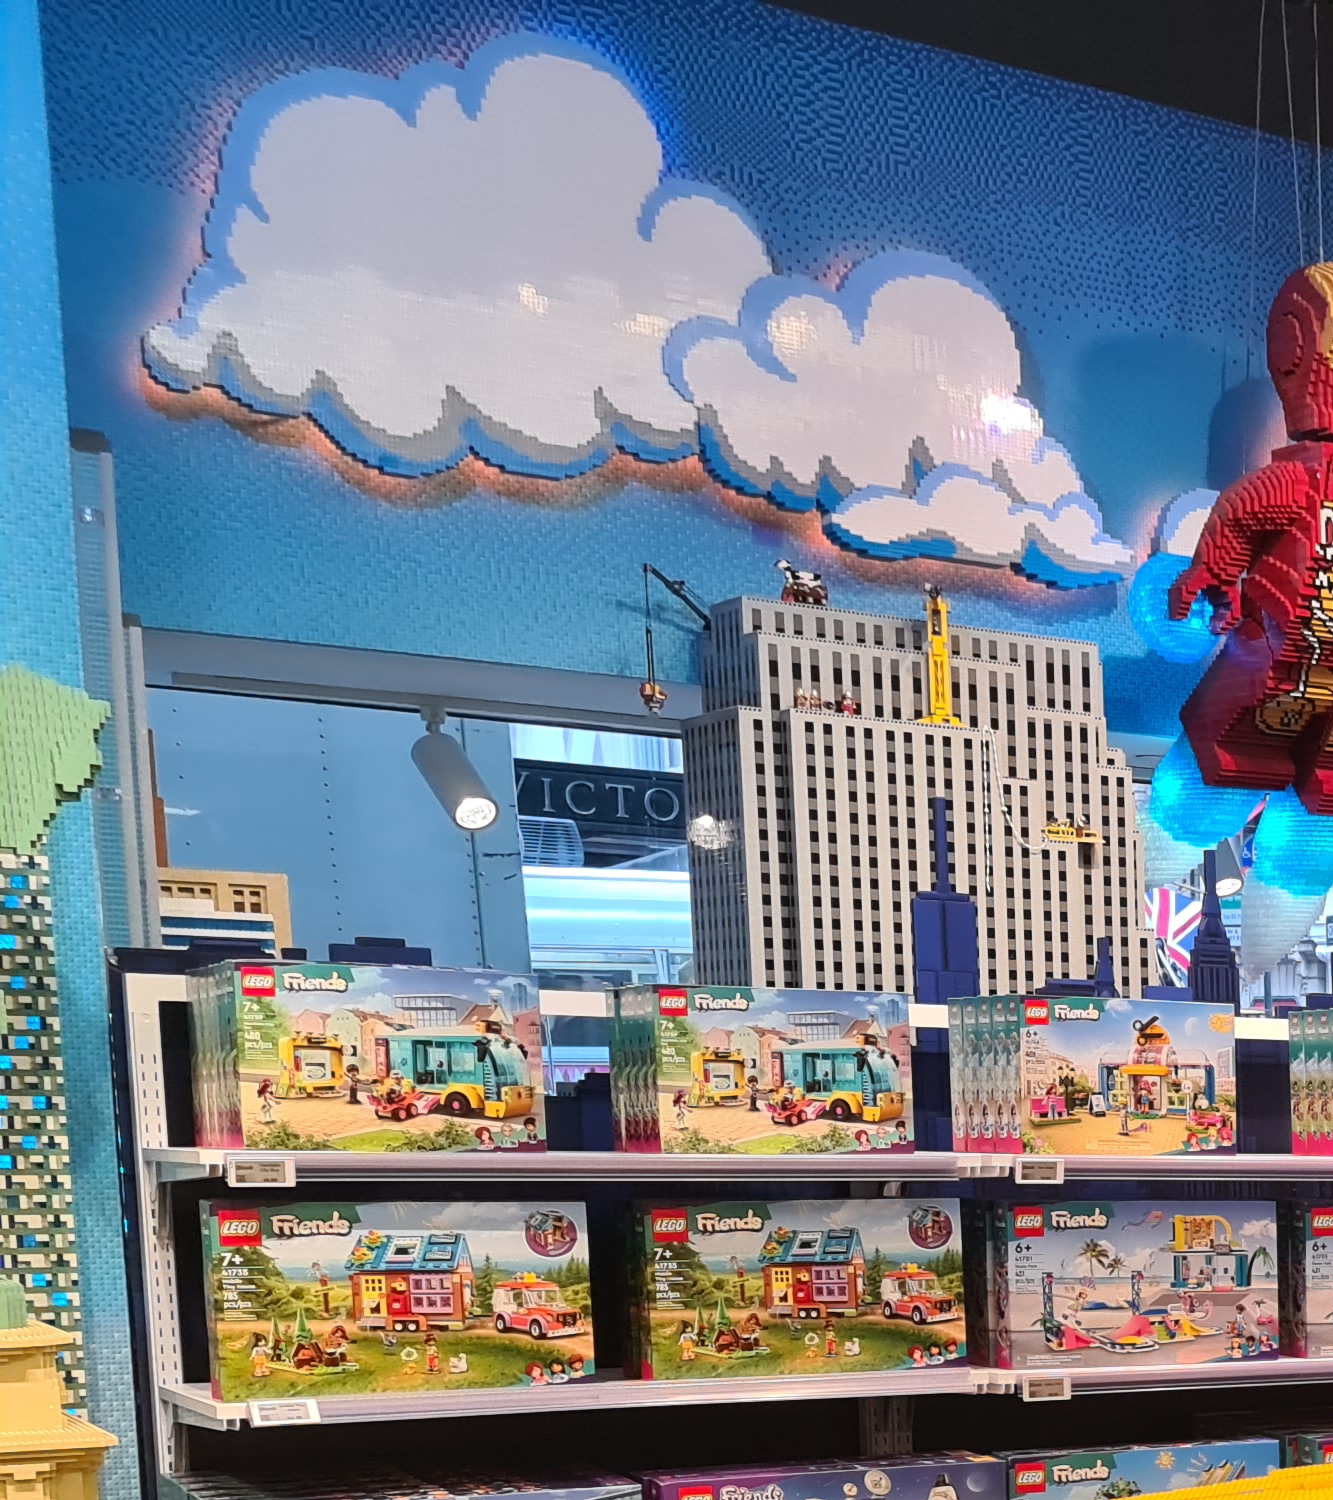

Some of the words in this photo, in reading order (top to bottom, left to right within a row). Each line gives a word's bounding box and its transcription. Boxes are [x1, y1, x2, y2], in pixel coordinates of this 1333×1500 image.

[244, 975, 273, 989] LEGO
[282, 971, 348, 993] Friends
[242, 1001, 260, 1012] 7+
[661, 998, 687, 1009] LEGO
[694, 992, 749, 1011] Friends
[1054, 1003, 1100, 1021] Friends
[660, 1020, 675, 1030] 7+
[1025, 1030, 1039, 1038] 6+
[221, 1220, 259, 1236] LEGO
[269, 1210, 352, 1236] Friends
[654, 1218, 686, 1232] LEGO
[695, 1208, 764, 1233] Friends
[1015, 1214, 1043, 1229] LEGO
[1050, 1207, 1109, 1229] Friends
[653, 1248, 673, 1260] 7+
[1015, 1243, 1032, 1253] 6+
[1312, 1241, 1327, 1252] 6+
[220, 1252, 244, 1267] 7+
[1016, 1471, 1044, 1485] LEGO
[1051, 1459, 1110, 1485] Friends
